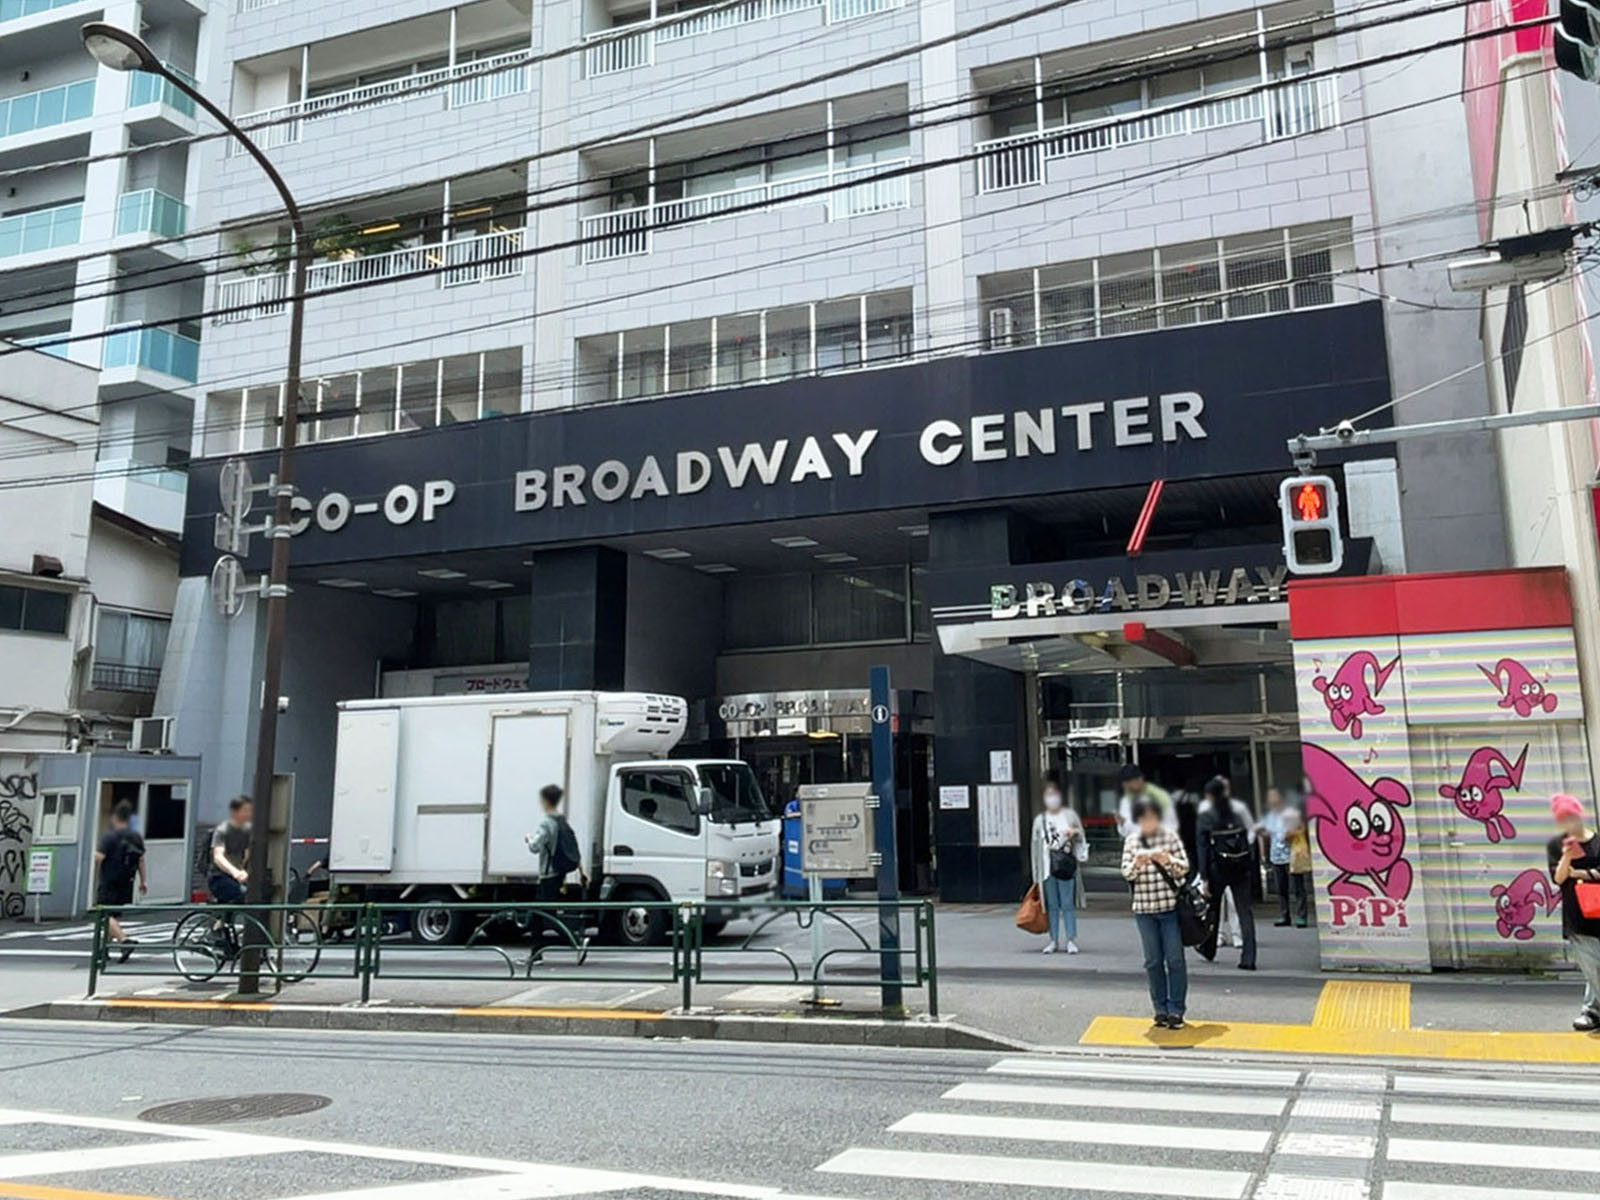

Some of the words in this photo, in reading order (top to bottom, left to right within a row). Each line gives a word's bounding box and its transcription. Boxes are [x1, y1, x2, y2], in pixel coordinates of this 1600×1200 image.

[291, 480, 456, 536] CO-OP
[514, 429, 878, 512] BROADWAY
[919, 391, 1208, 463] CENTER
[991, 565, 1288, 619] BROADWAY
